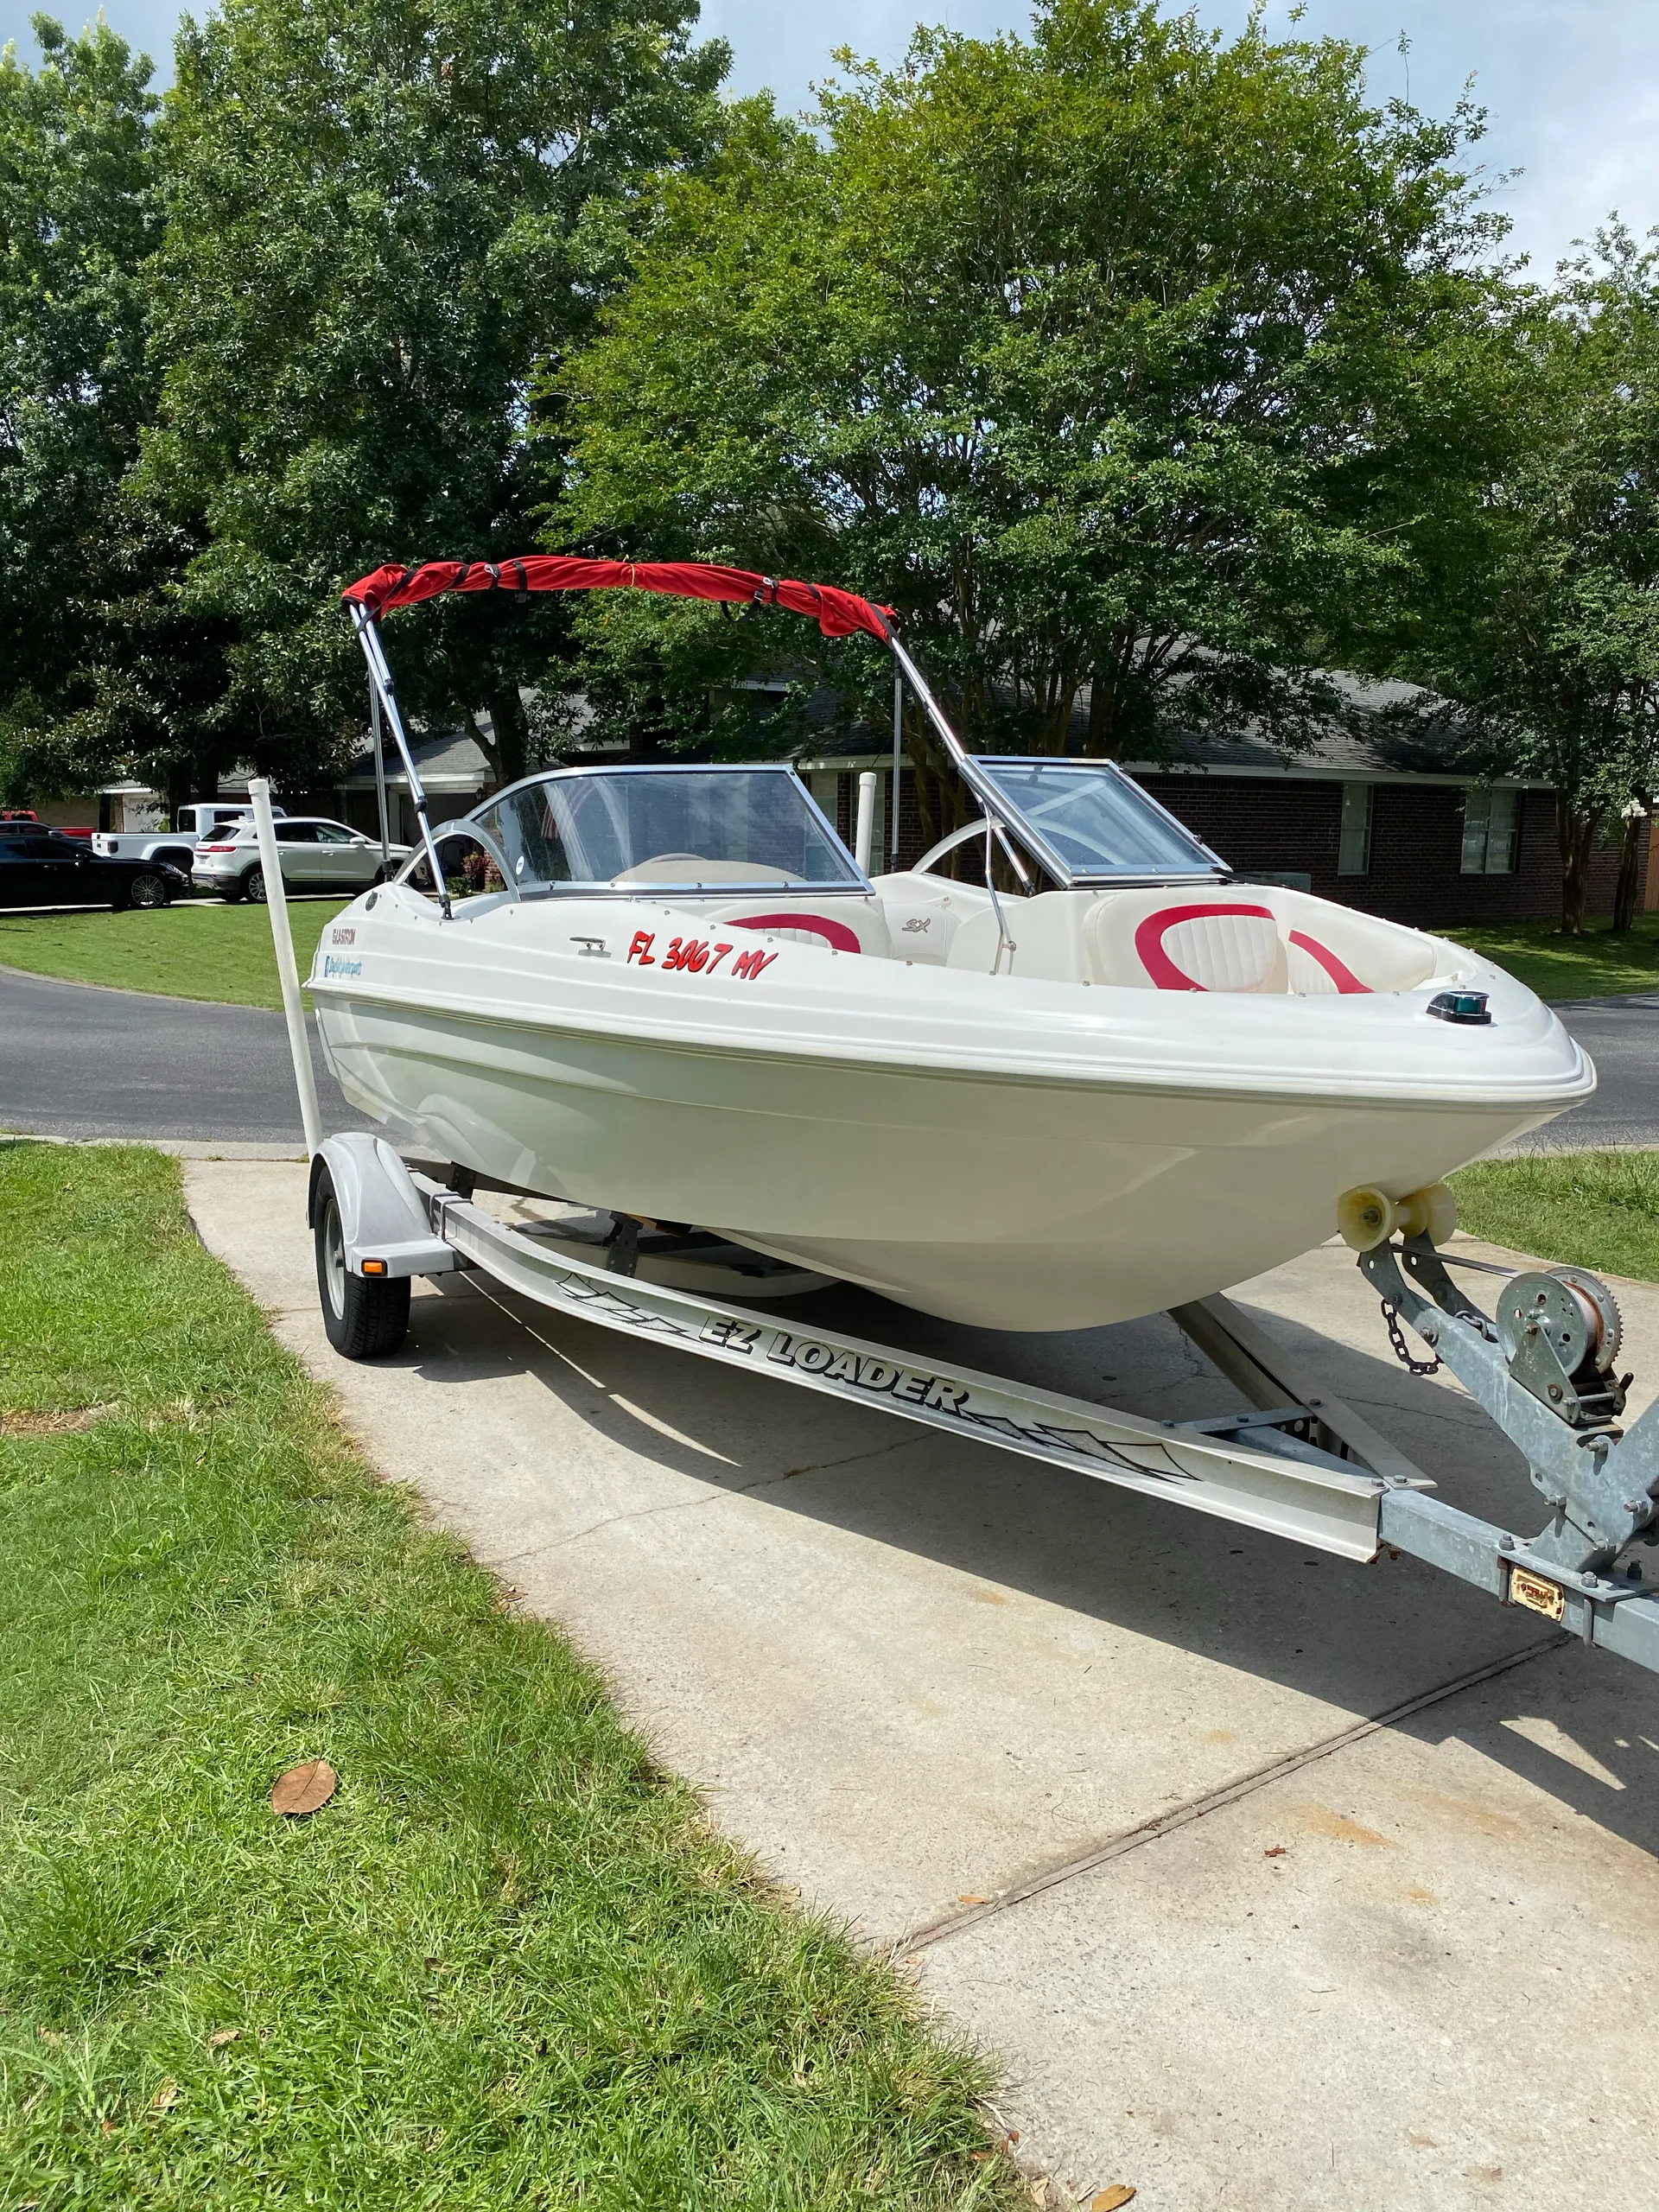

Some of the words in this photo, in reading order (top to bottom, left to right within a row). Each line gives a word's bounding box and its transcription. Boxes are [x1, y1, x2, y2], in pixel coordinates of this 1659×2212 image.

[901, 918, 931, 933] SX
[626, 931, 656, 965] FL
[661, 937, 734, 975] 3067
[698, 1316, 762, 1355] EZ
[766, 1331, 970, 1415] LOADER
